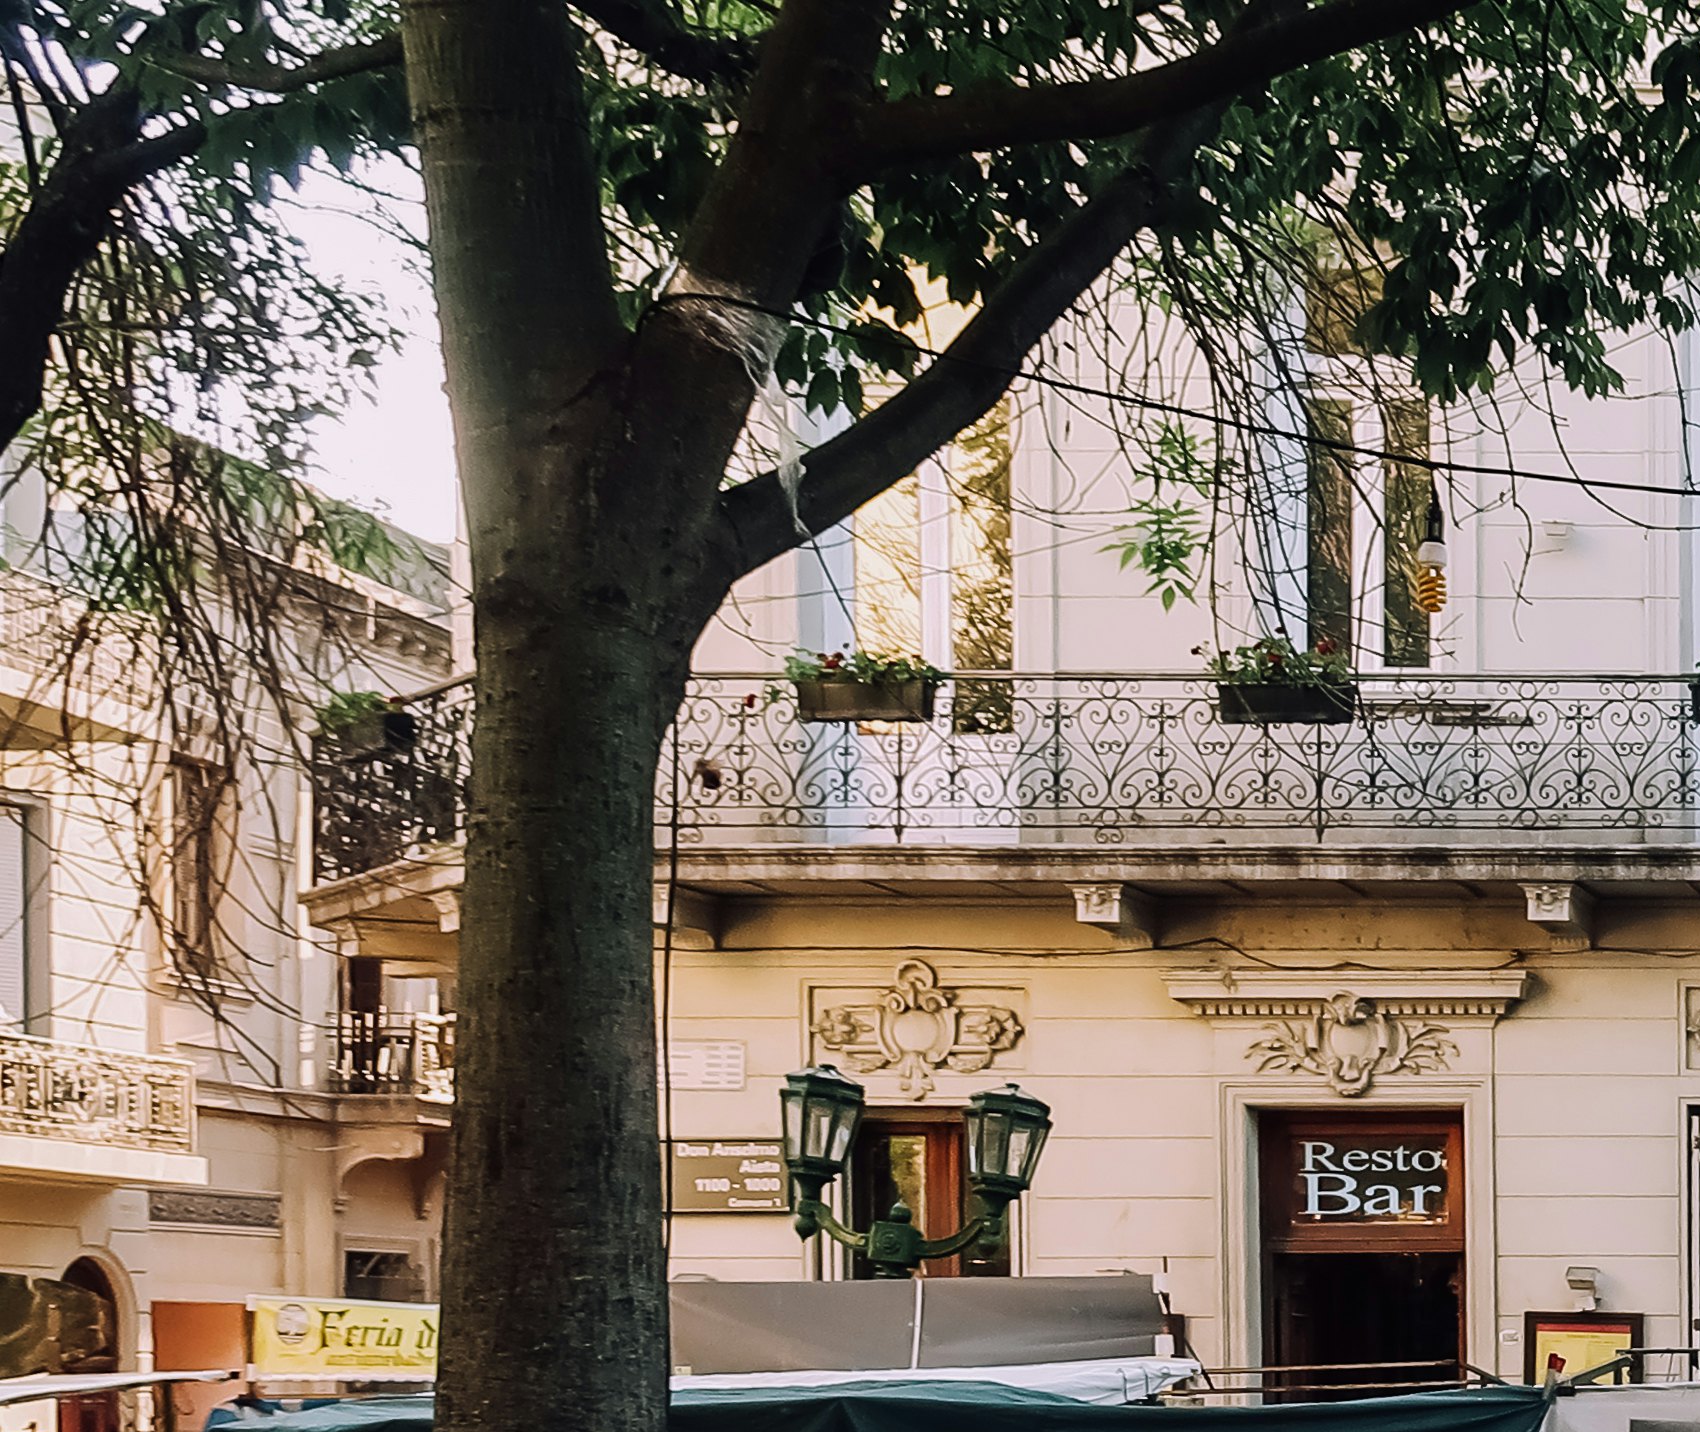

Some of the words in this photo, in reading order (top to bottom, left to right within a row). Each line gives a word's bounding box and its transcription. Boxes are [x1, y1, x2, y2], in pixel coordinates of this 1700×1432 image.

[1298, 1141, 1442, 1172] Resto
[1298, 1172, 1442, 1215] Bar
[317, 1308, 404, 1349] Feria
[415, 1318, 437, 1350] d
